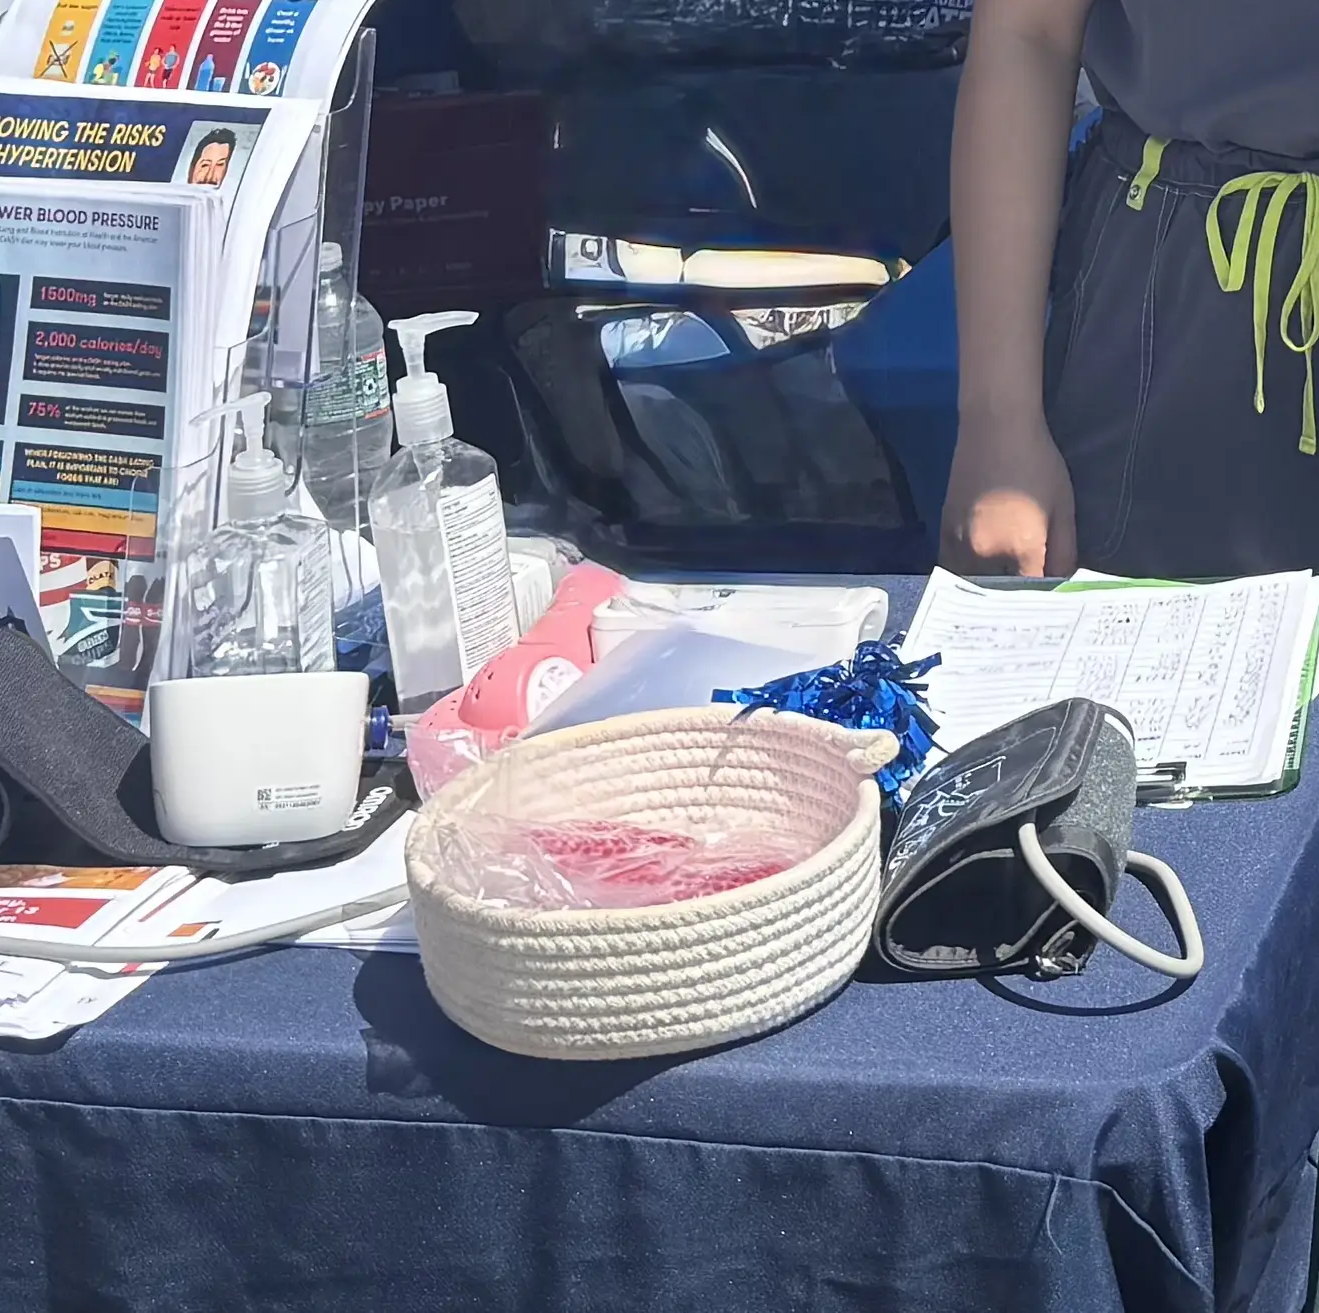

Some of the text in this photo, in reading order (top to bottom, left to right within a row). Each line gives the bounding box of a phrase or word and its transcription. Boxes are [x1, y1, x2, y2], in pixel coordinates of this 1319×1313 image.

[74, 122, 107, 144] THE
[110, 124, 167, 147] RISKS
[389, 195, 449, 213] Paper
[37, 207, 88, 226] BLOOD
[92, 211, 160, 231] PRESSURE
[35, 331, 163, 359] 2,000 calories/day
[27, 401, 61, 418] 75%
